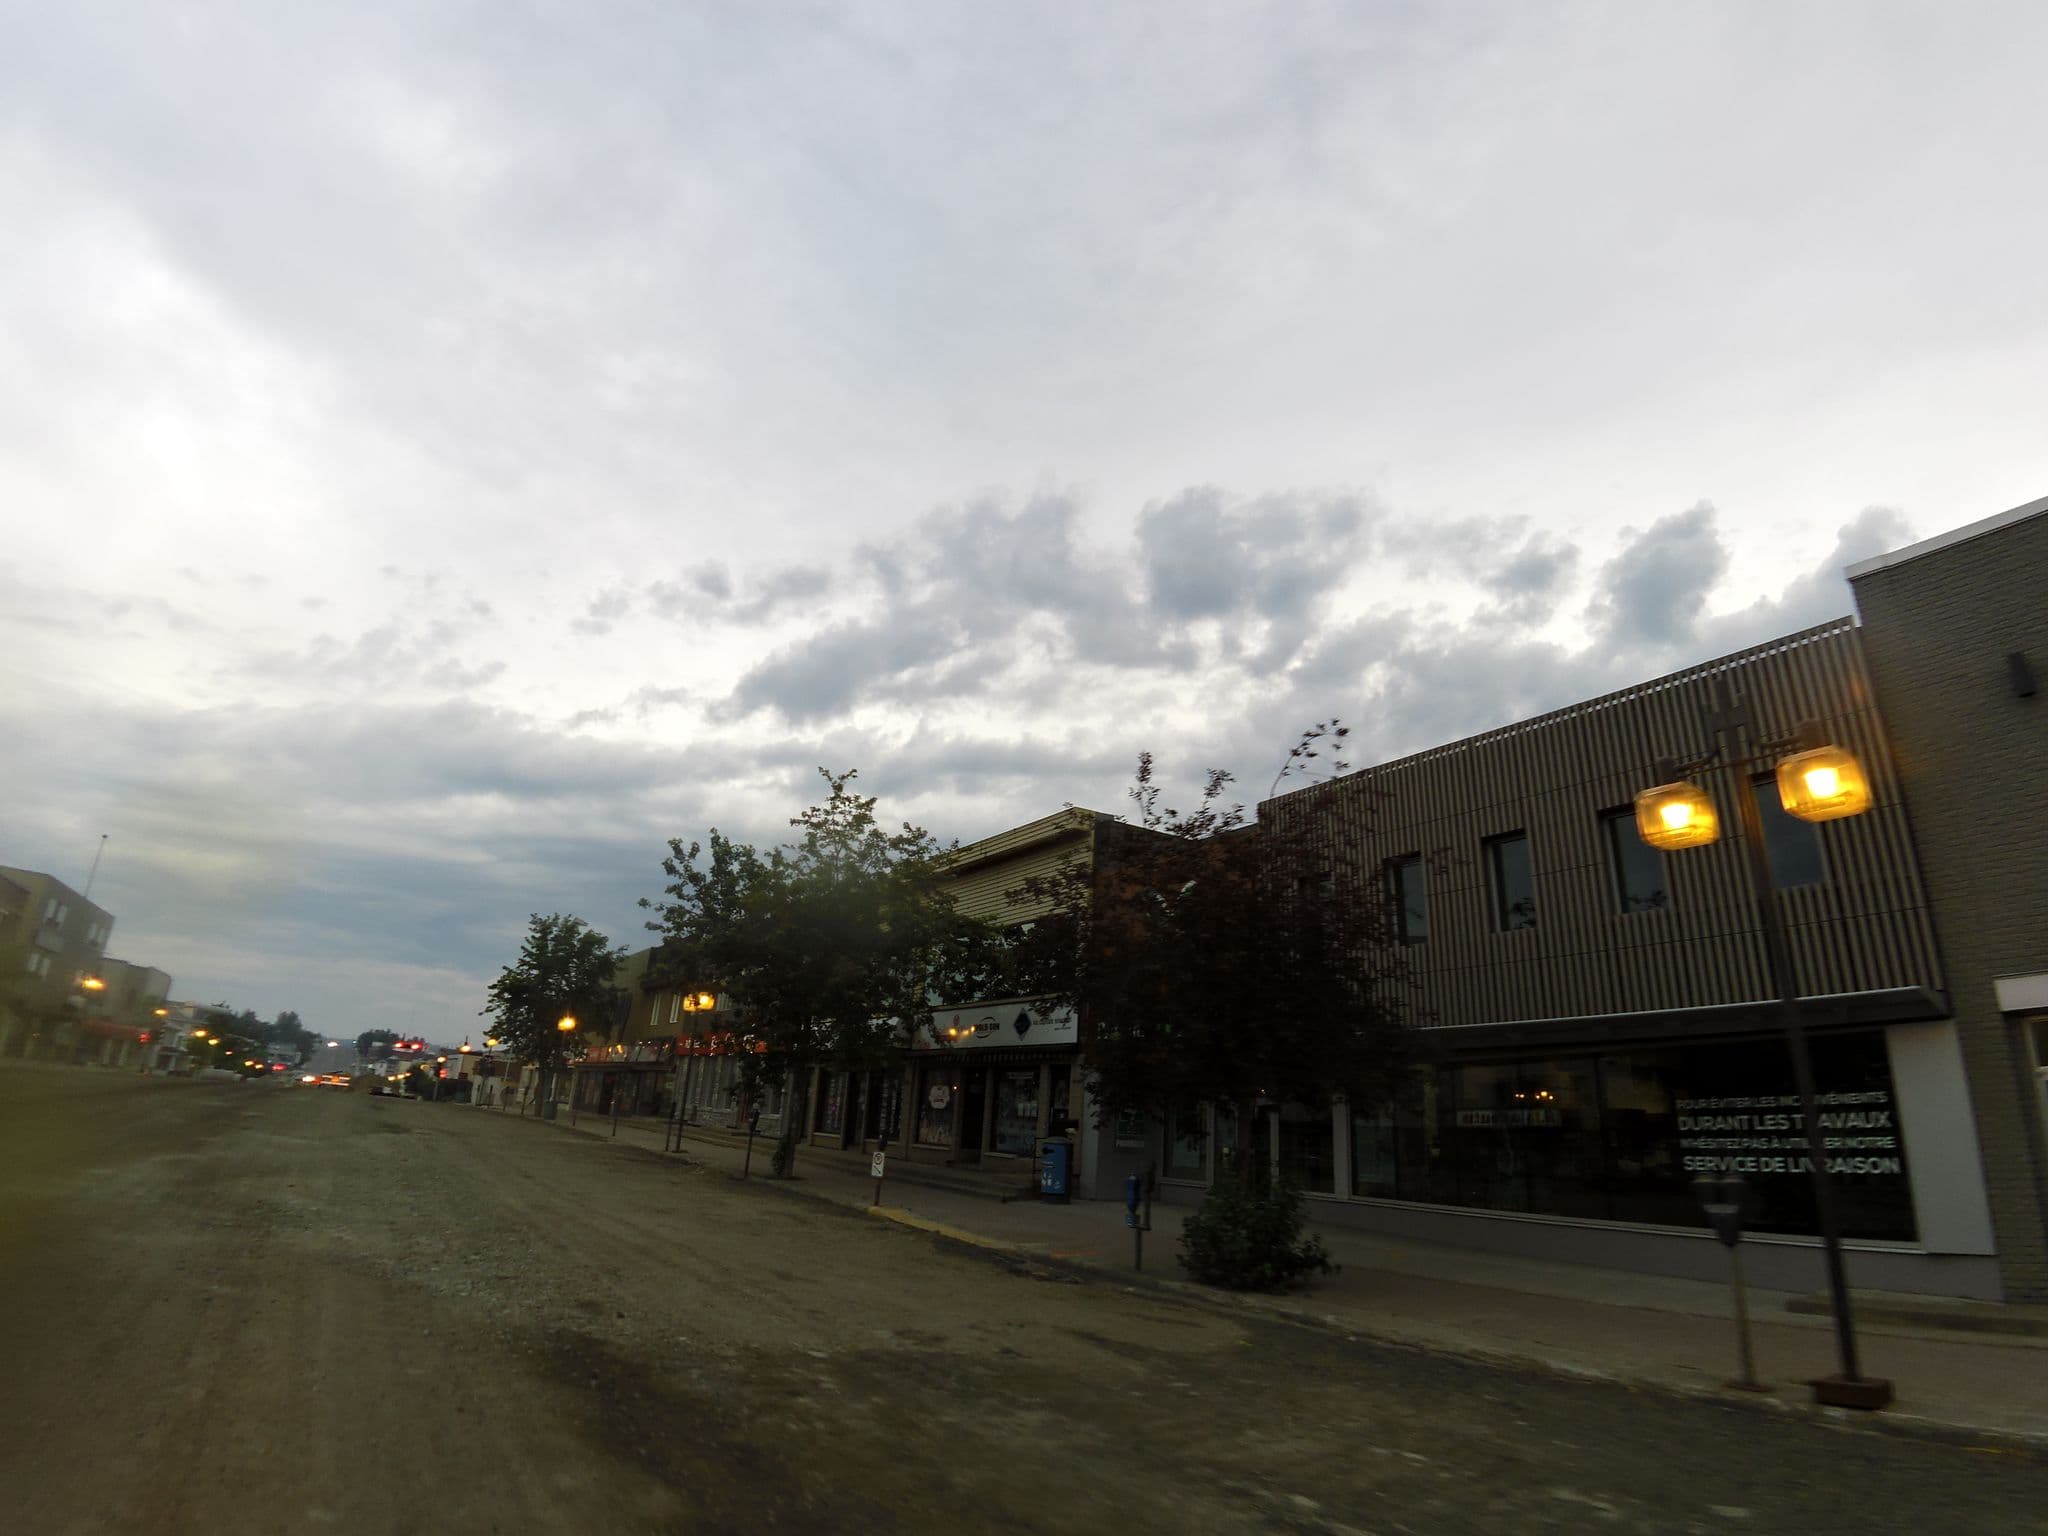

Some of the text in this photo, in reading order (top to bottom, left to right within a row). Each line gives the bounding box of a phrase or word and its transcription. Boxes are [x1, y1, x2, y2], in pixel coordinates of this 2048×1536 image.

[1679, 1111, 1894, 1131] DURANT LES TAVAUX
[1683, 1155, 1759, 1172] SERVICE
[1760, 1156, 1787, 1173] DE
